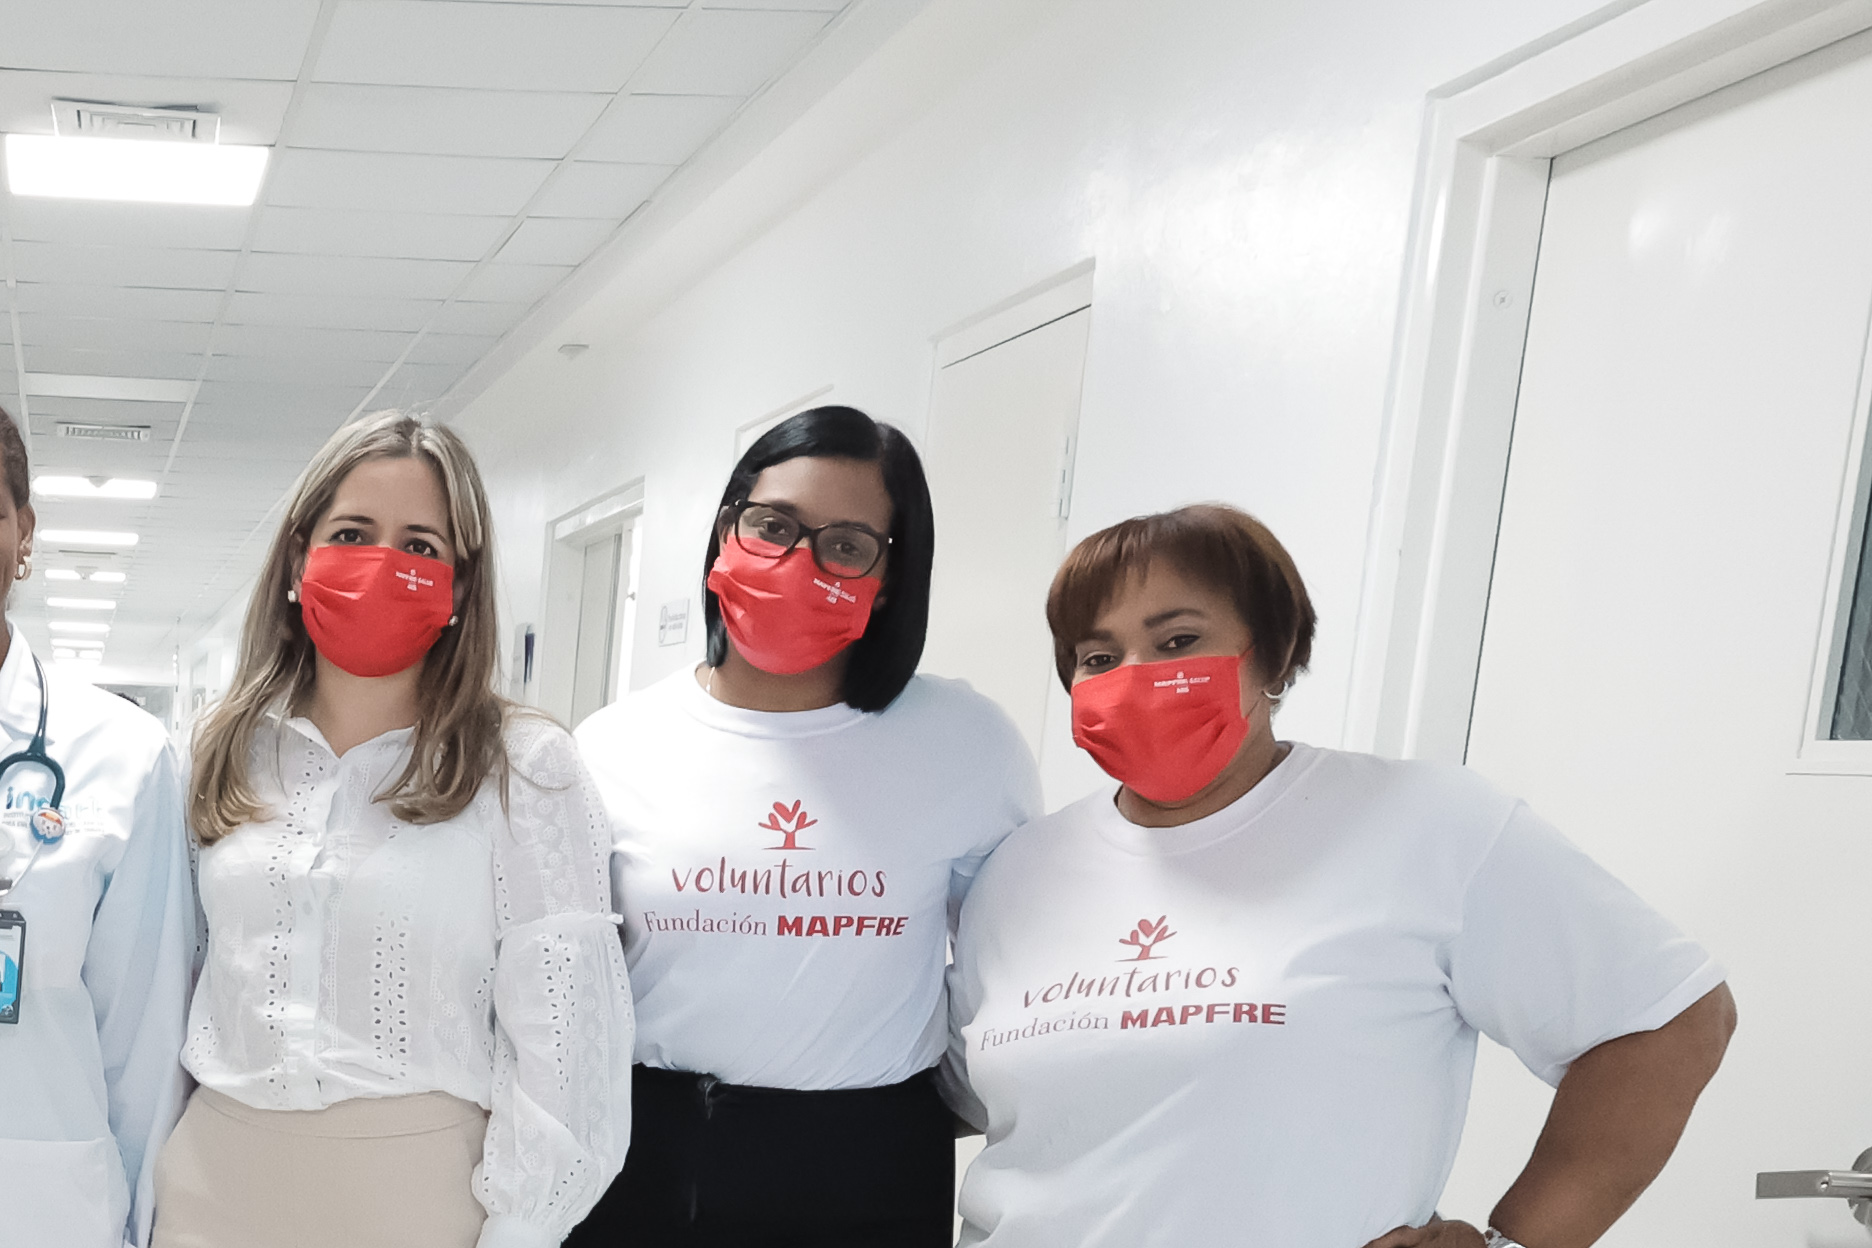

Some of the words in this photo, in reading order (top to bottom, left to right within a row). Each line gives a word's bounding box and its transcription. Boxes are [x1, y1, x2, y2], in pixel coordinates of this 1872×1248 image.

[672, 856, 887, 899] voluntarios
[643, 908, 767, 936] Fundación
[777, 915, 909, 937] MAPFRE
[1023, 967, 1240, 1009] voluntarios
[980, 1011, 1109, 1051] Fundación
[1120, 1003, 1287, 1029] MAPFRE
